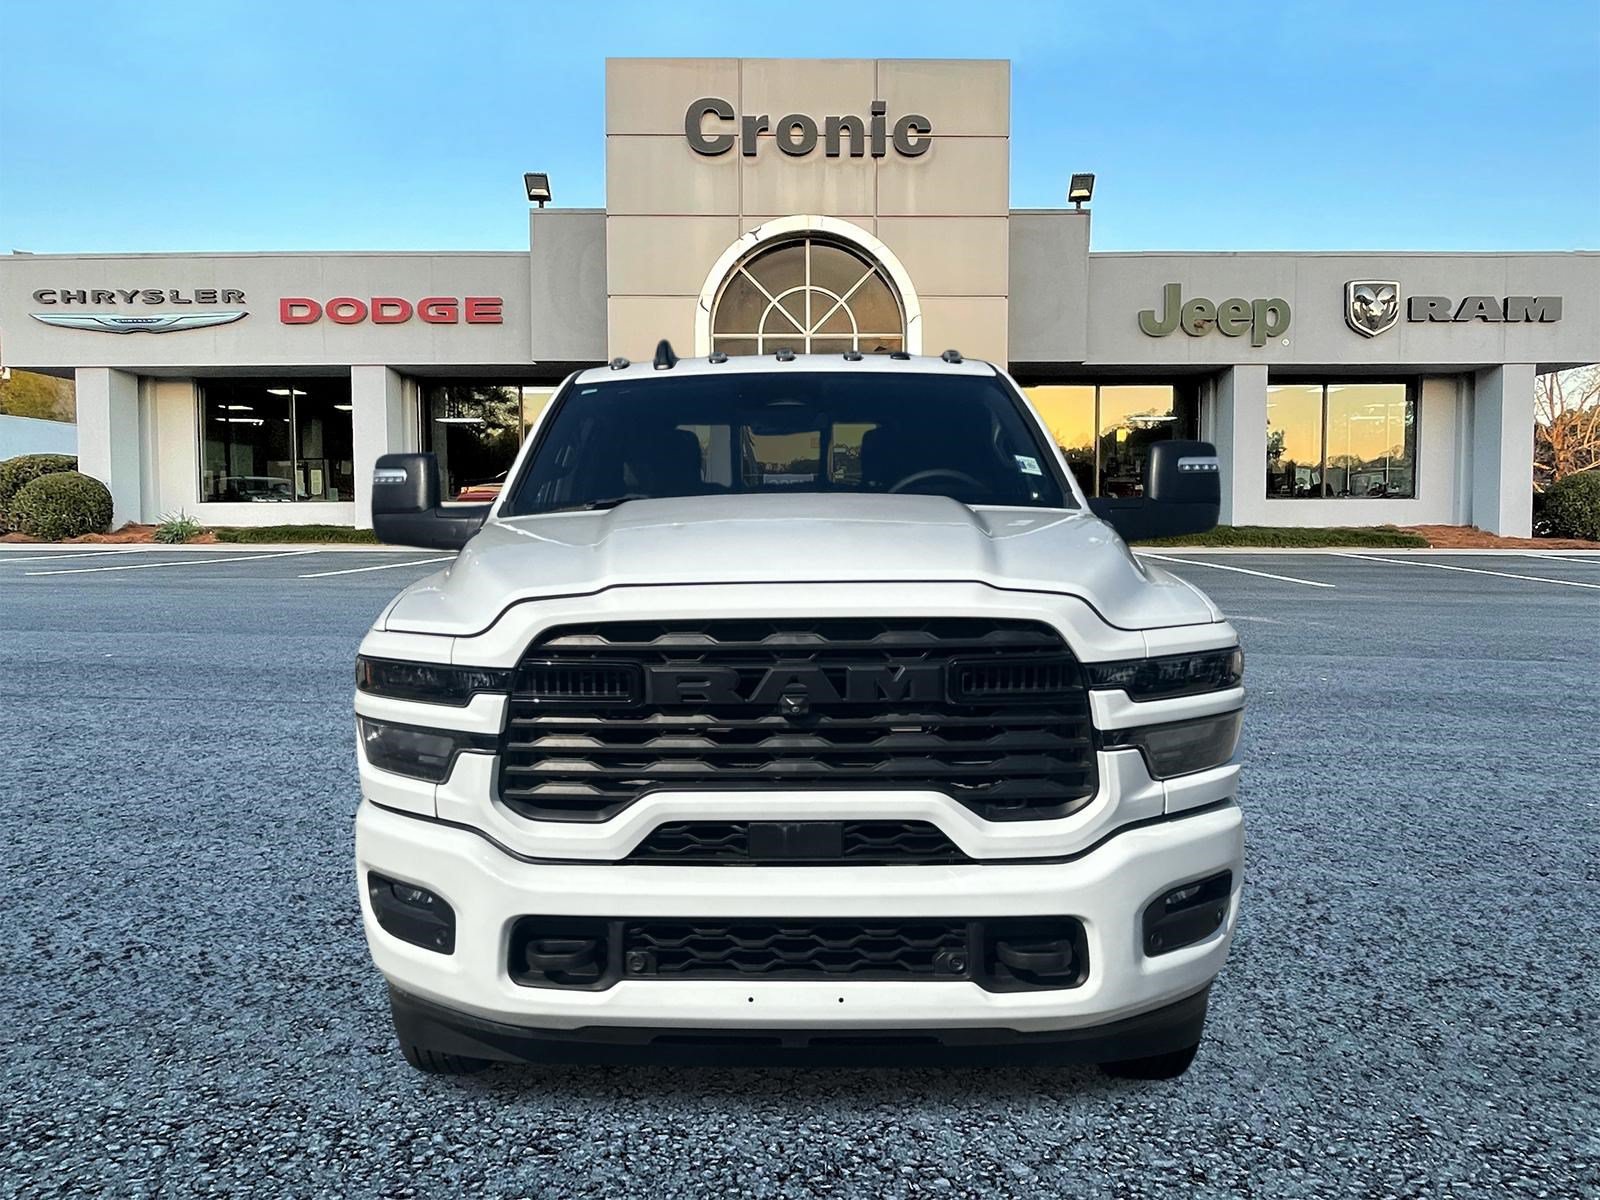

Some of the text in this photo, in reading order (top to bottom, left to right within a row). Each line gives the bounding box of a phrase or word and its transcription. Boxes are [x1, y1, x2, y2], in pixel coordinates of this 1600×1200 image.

[685, 98, 932, 157] Cronic
[32, 289, 246, 304] CHRYSLER
[279, 297, 503, 324] DODGE
[1407, 296, 1563, 322] RAM
[1138, 283, 1291, 347] Jeep
[647, 665, 945, 704] RAM
